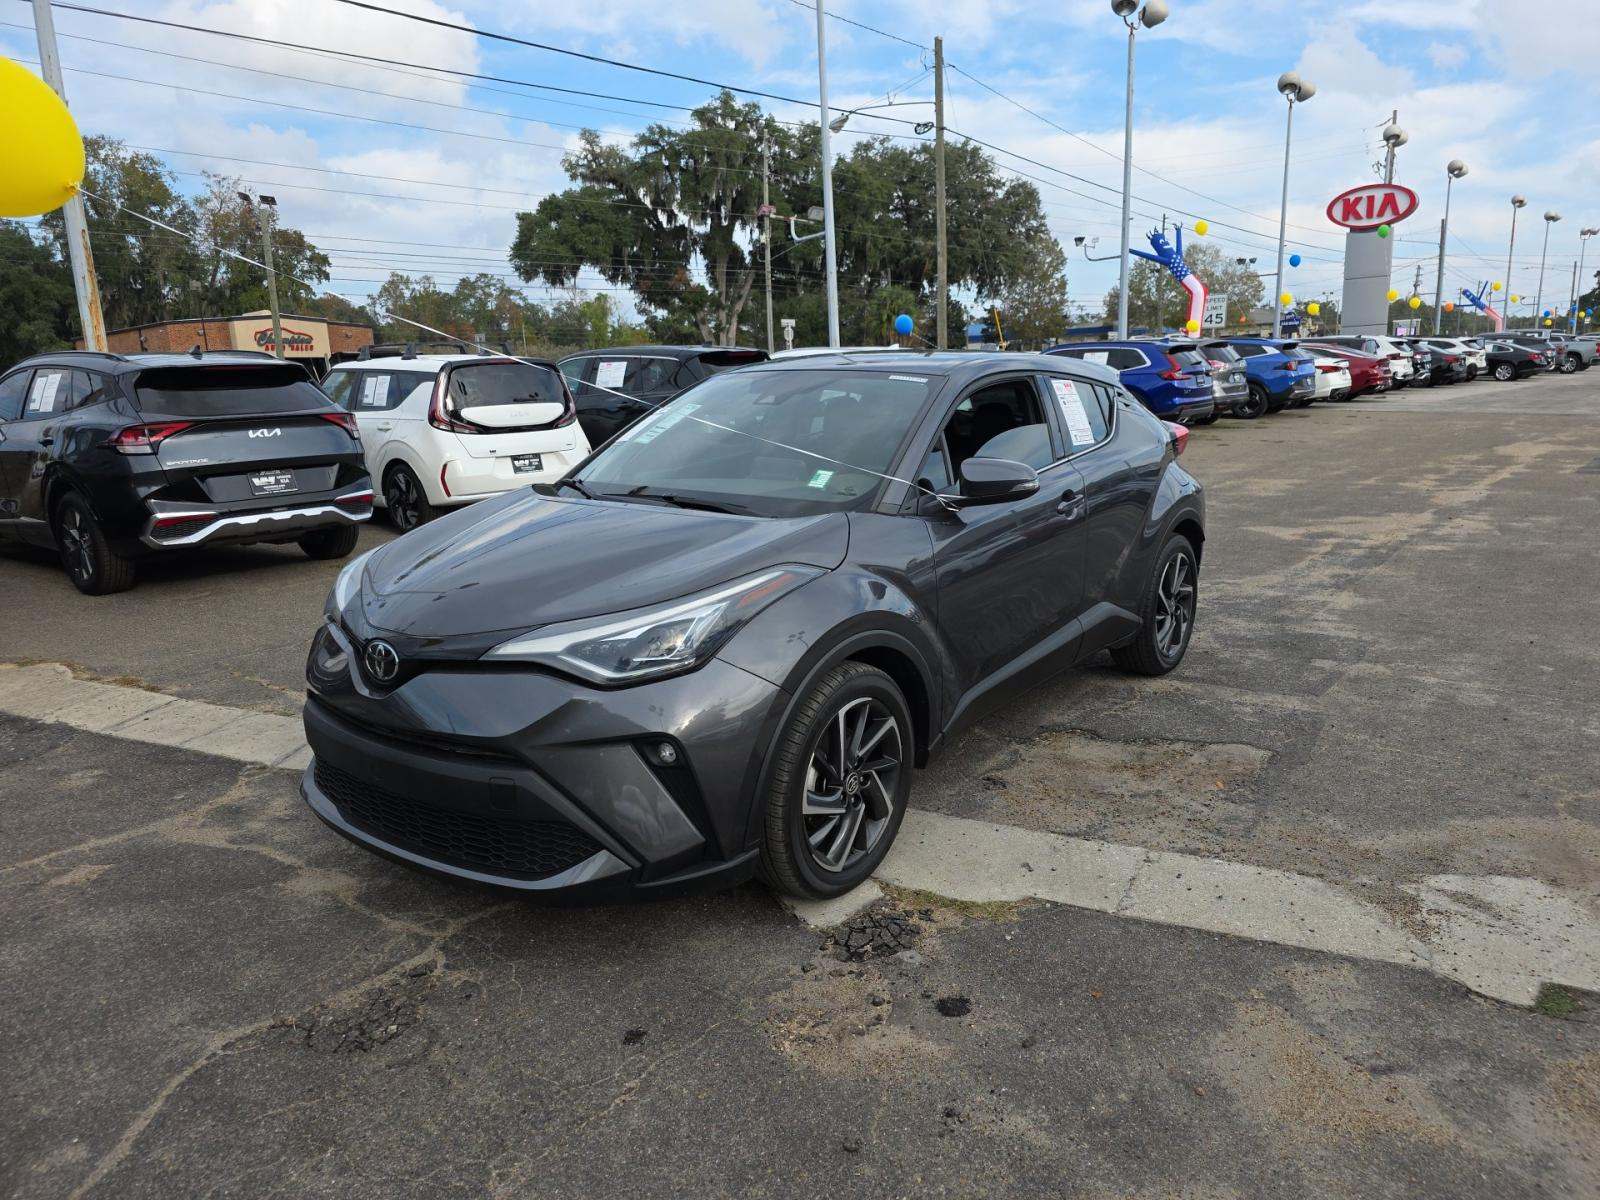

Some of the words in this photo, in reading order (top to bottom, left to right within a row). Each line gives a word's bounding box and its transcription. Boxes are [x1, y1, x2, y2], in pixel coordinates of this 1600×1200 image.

[1341, 192, 1401, 222] KIA
[1204, 313, 1224, 325] 45
[257, 331, 313, 347] Chmpion
[264, 344, 286, 352] AUO
[290, 344, 314, 352] SALES
[248, 428, 281, 438] KIA
